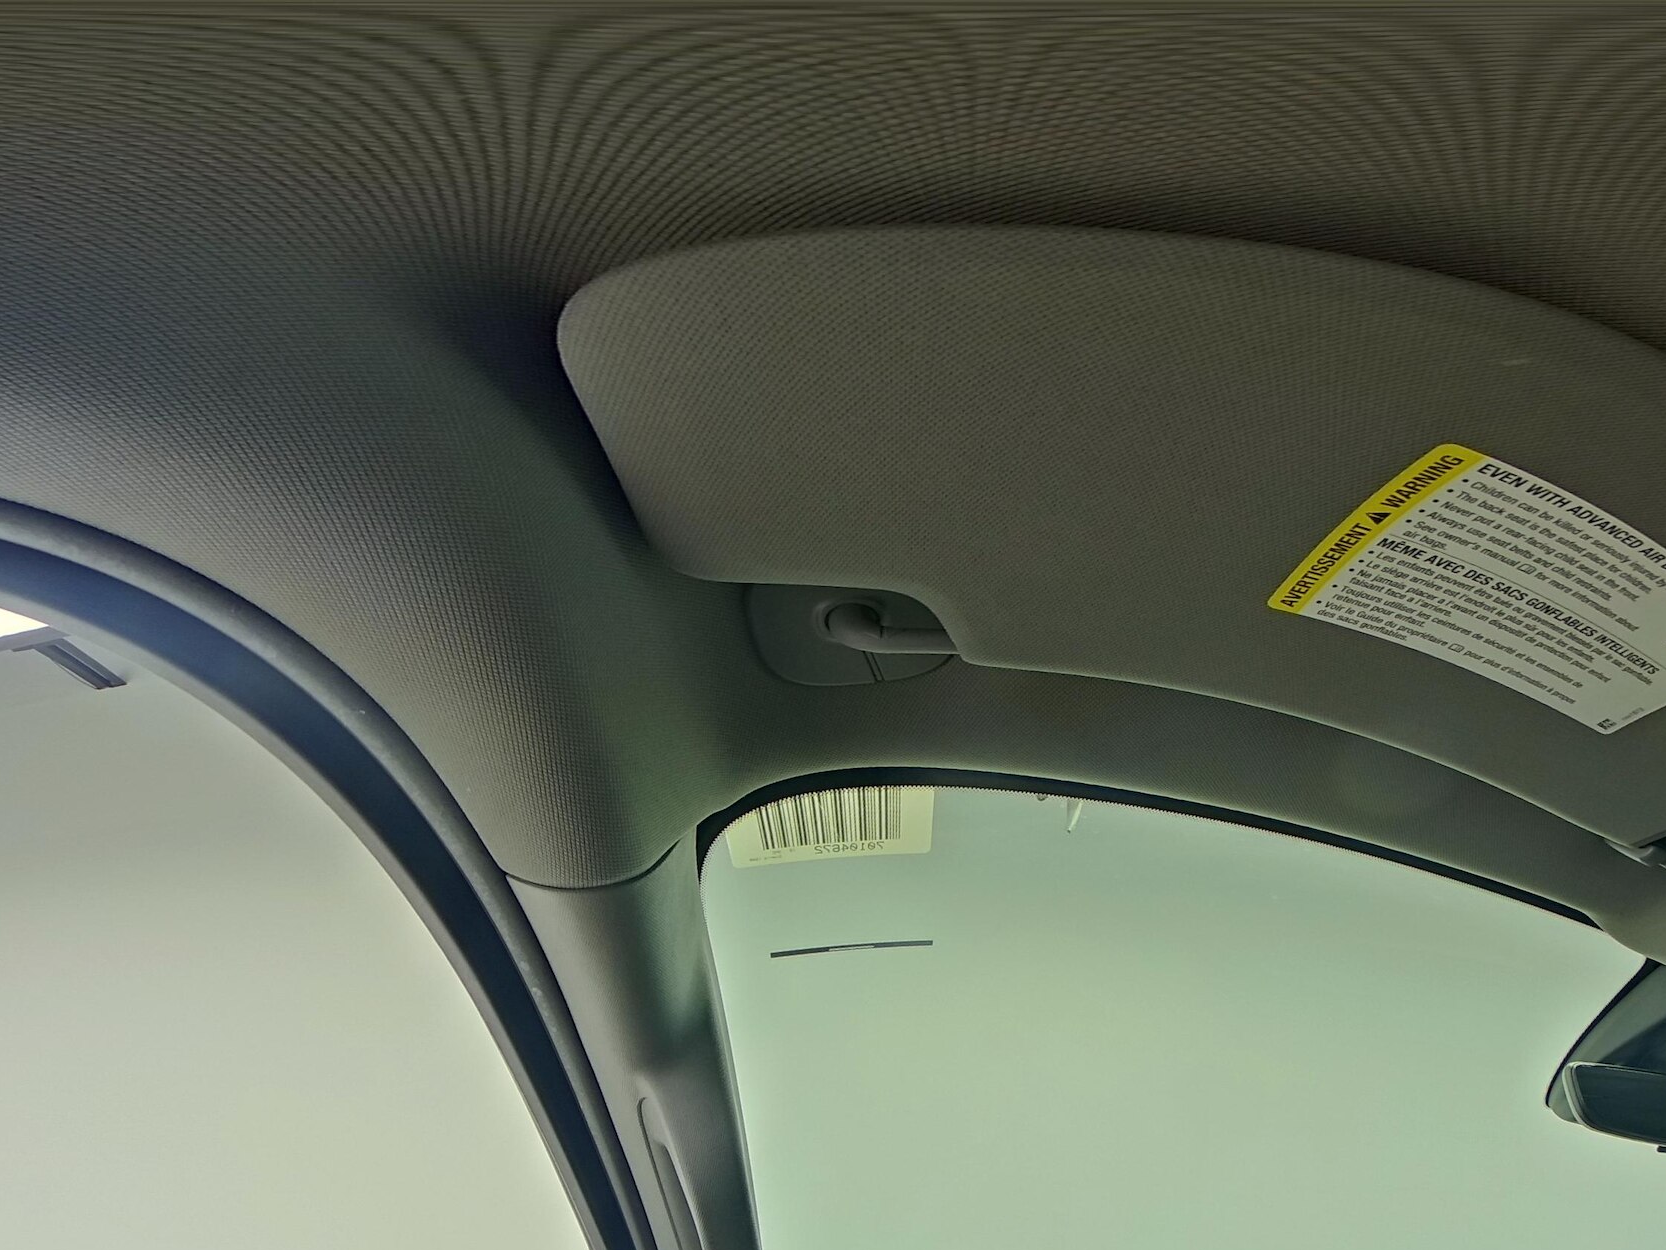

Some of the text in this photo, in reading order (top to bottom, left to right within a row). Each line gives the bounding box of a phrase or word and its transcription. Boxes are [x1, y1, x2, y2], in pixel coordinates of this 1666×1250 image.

[1279, 454, 1465, 608] AVERTISSEMENT WARNING
[1456, 490, 1479, 504] The
[1476, 499, 1507, 516] back
[1504, 512, 1532, 527] seat
[1527, 522, 1541, 531] is
[1538, 527, 1557, 539] the
[1554, 536, 1588, 554] safest
[1580, 551, 1609, 567] place
[1606, 564, 1623, 574] for
[1470, 481, 1519, 505] Children
[1516, 502, 1541, 515] can
[1537, 510, 1555, 522] be
[1552, 518, 1584, 536] killed
[1578, 533, 1594, 541] or
[1590, 539, 1632, 564] seriously
[1476, 463, 1530, 488] EVEN
[1524, 483, 1573, 509] WITH
[1565, 505, 1645, 549] ADVANCED
[1637, 547, 1666, 564] AIR
[1402, 530, 1448, 551] air bags.
[1413, 520, 1438, 534] See
[1436, 530, 1482, 551] owner's
[1479, 548, 1522, 568] manual
[1533, 571, 1551, 582] for
[1547, 579, 1574, 594] more
[1425, 511, 1468, 530] Always
[1465, 527, 1488, 539] use
[1485, 535, 1512, 549] seat
[1508, 544, 1535, 560] belts
[1532, 557, 1556, 569] and
[1550, 566, 1577, 580] child
[1439, 500, 1477, 518] Never
[1471, 515, 1496, 527] put
[1501, 527, 1557, 556] rear-facing
[1553, 552, 1581, 566] child
[1575, 563, 1599, 577] seat
[1594, 574, 1607, 582] in
[1348, 576, 1408, 600] faisant face
[1356, 569, 1373, 579] Ne
[1369, 574, 1408, 591] jamais
[1404, 587, 1439, 601] placer
[1475, 613, 1490, 622] un
[1365, 560, 1381, 570] Le
[1380, 566, 1410, 580] siège
[1442, 588, 1461, 598] est
[1375, 551, 1397, 563] Les
[1396, 559, 1436, 577] enfants
[1432, 573, 1476, 592] peuvent
[1316, 609, 1337, 619] des
[1335, 615, 1360, 626] sacs
[1324, 600, 1346, 612] Voir
[1344, 606, 1356, 616] le
[1355, 610, 1385, 624] Guide
[1383, 620, 1398, 629] du
[1331, 593, 1372, 609] retenue
[1368, 605, 1396, 616] pour
[1340, 585, 1384, 604] Toujours
[1382, 600, 1418, 615] utiliser
[1415, 610, 1433, 621] les
[1430, 617, 1473, 636] ceintures
[1375, 537, 1428, 560] MÊME
[1422, 554, 1466, 574] AVEC
[1461, 569, 1495, 586] DES
[1490, 581, 1529, 602] SACS
[1524, 597, 1599, 638] GONFLABLES
[1593, 633, 1661, 675] INTELLIGENTS
